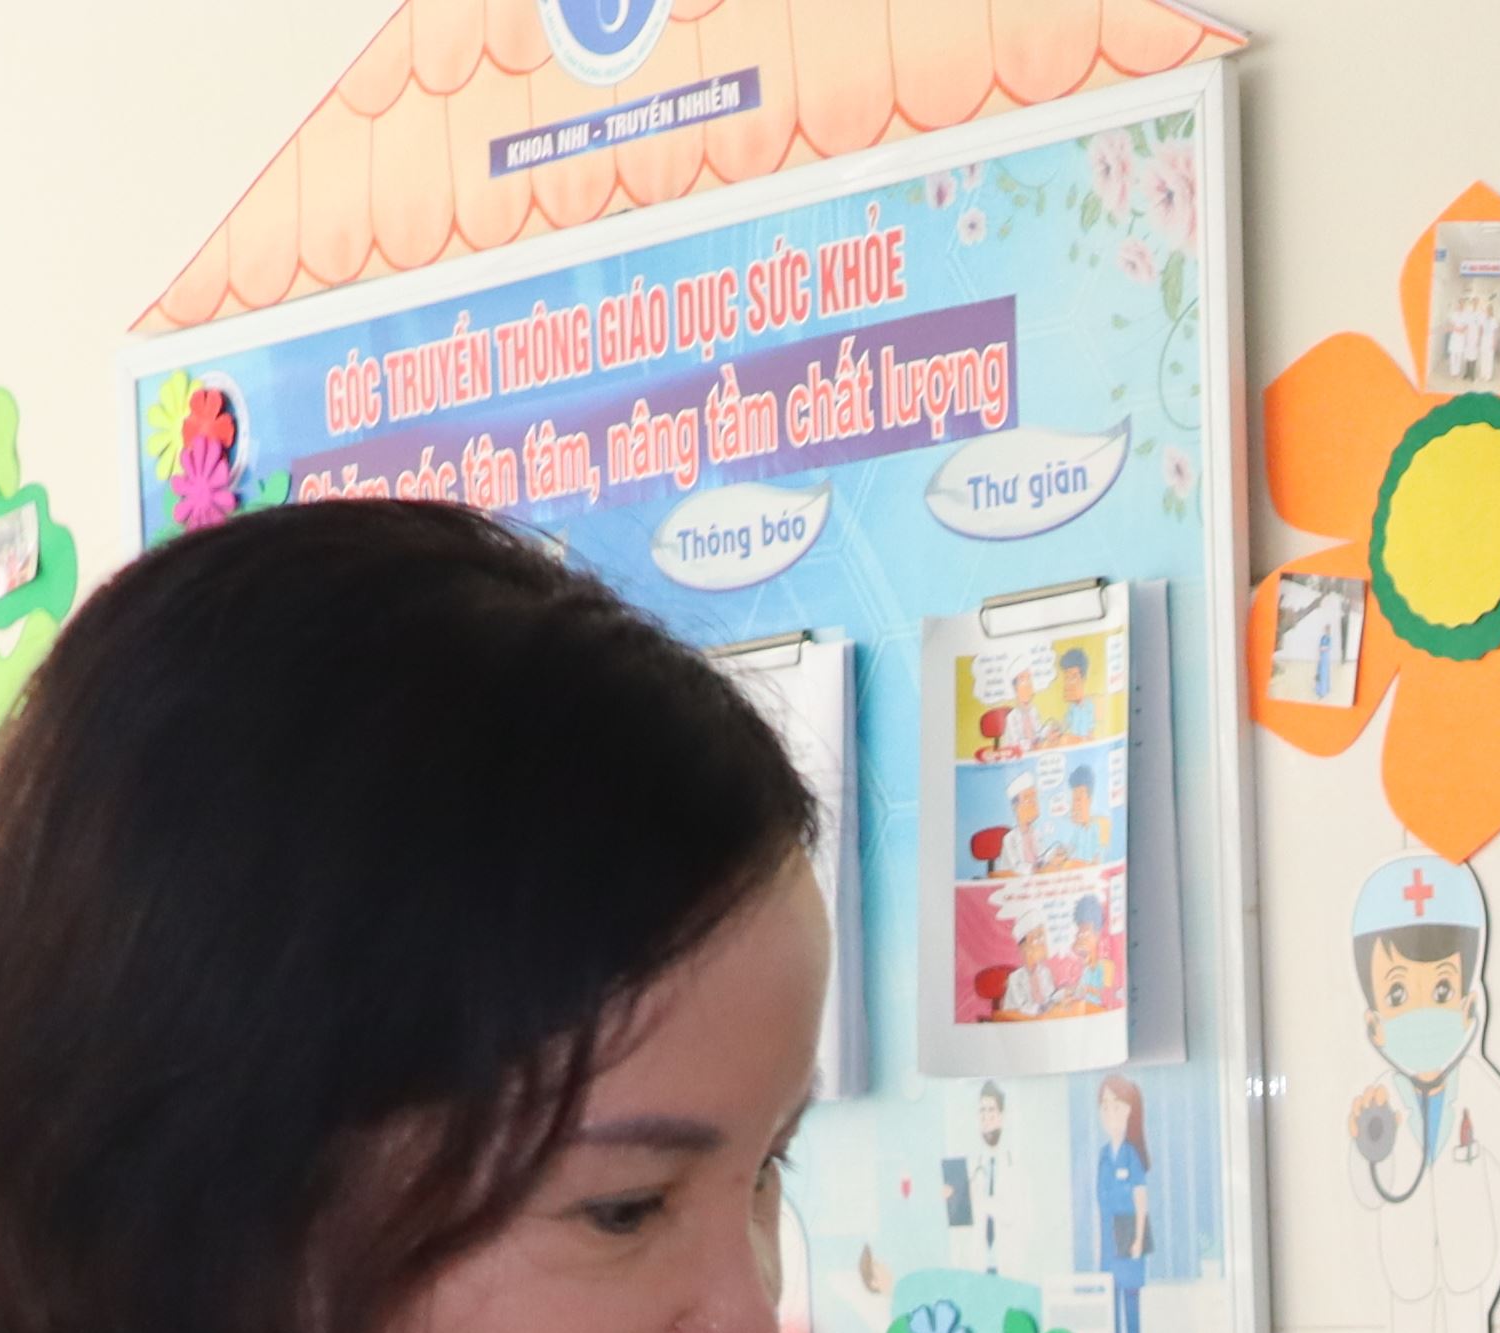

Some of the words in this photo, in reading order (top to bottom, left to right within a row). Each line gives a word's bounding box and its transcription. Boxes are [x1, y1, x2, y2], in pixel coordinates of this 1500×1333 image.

[506, 132, 553, 168] KHOA
[557, 123, 590, 154] NHI
[326, 349, 382, 436] GÓC
[495, 300, 593, 396] THÔNG
[598, 275, 668, 371] GIÁO
[674, 267, 739, 362] DỤC
[746, 235, 811, 336] SỨC
[817, 202, 906, 319] KHỎE
[522, 419, 601, 505] tâm,
[607, 397, 699, 489] nâng
[705, 362, 778, 464] tầm
[786, 335, 875, 448] chất
[881, 342, 1010, 440] lượng
[967, 473, 1019, 511] Thư
[762, 508, 805, 547] báo
